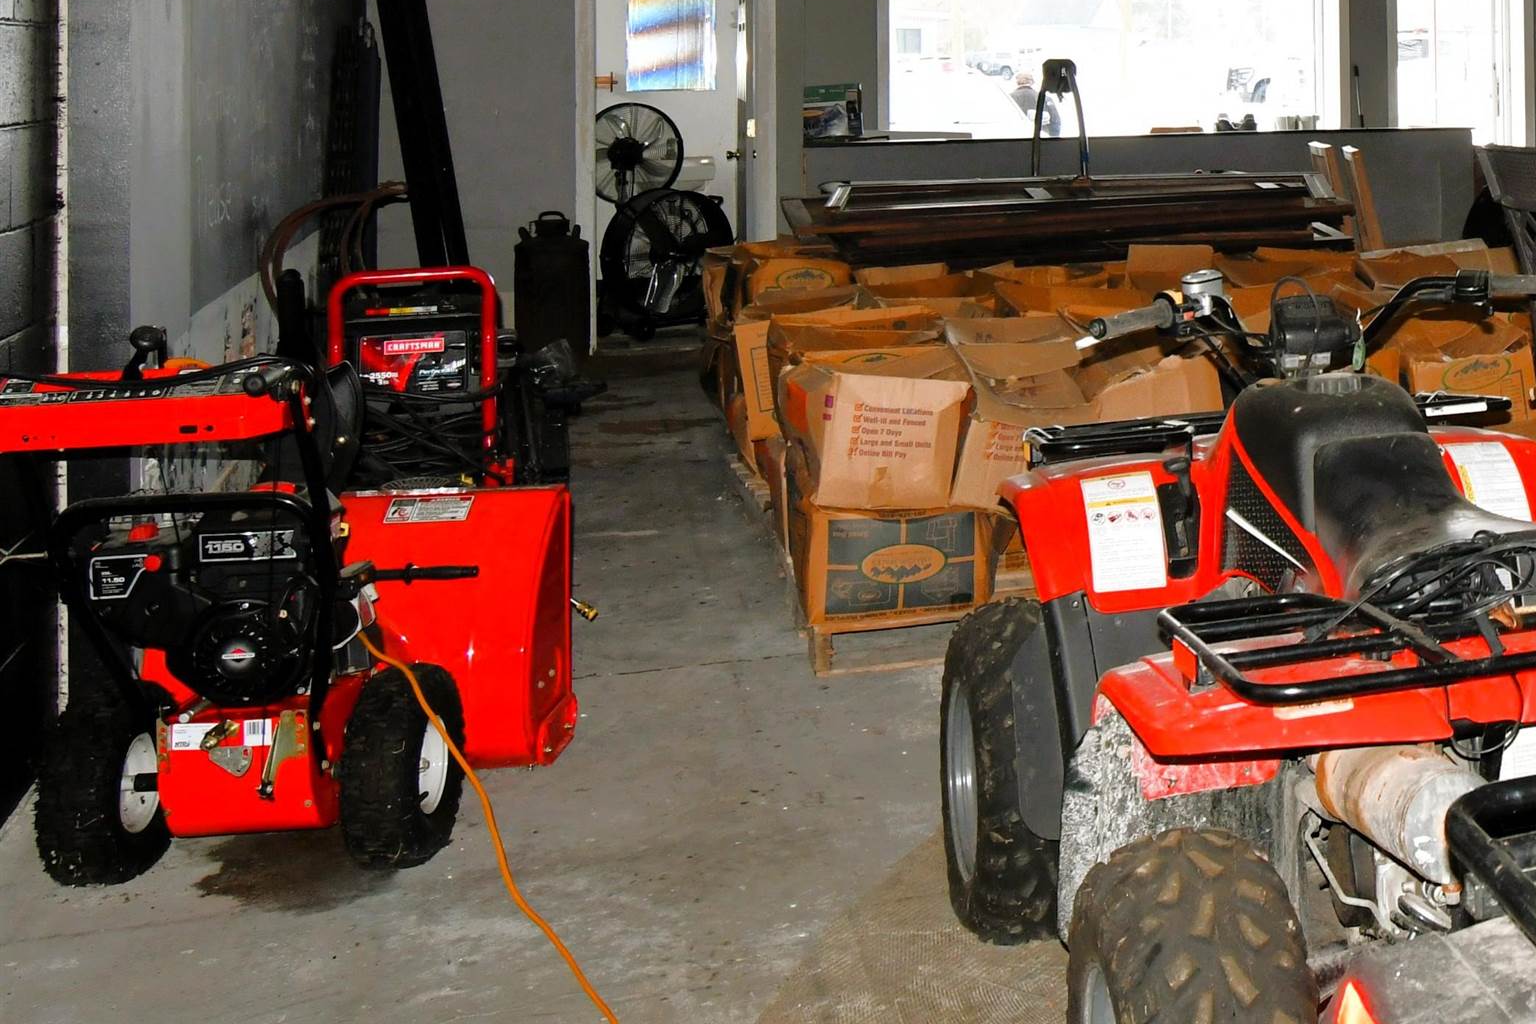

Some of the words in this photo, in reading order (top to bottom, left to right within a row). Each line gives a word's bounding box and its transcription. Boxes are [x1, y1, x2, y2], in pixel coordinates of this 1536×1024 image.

[387, 341, 441, 351] CRAFTSMAN
[861, 427, 879, 436] Open
[886, 429, 902, 437] Days
[860, 438, 879, 447] Large
